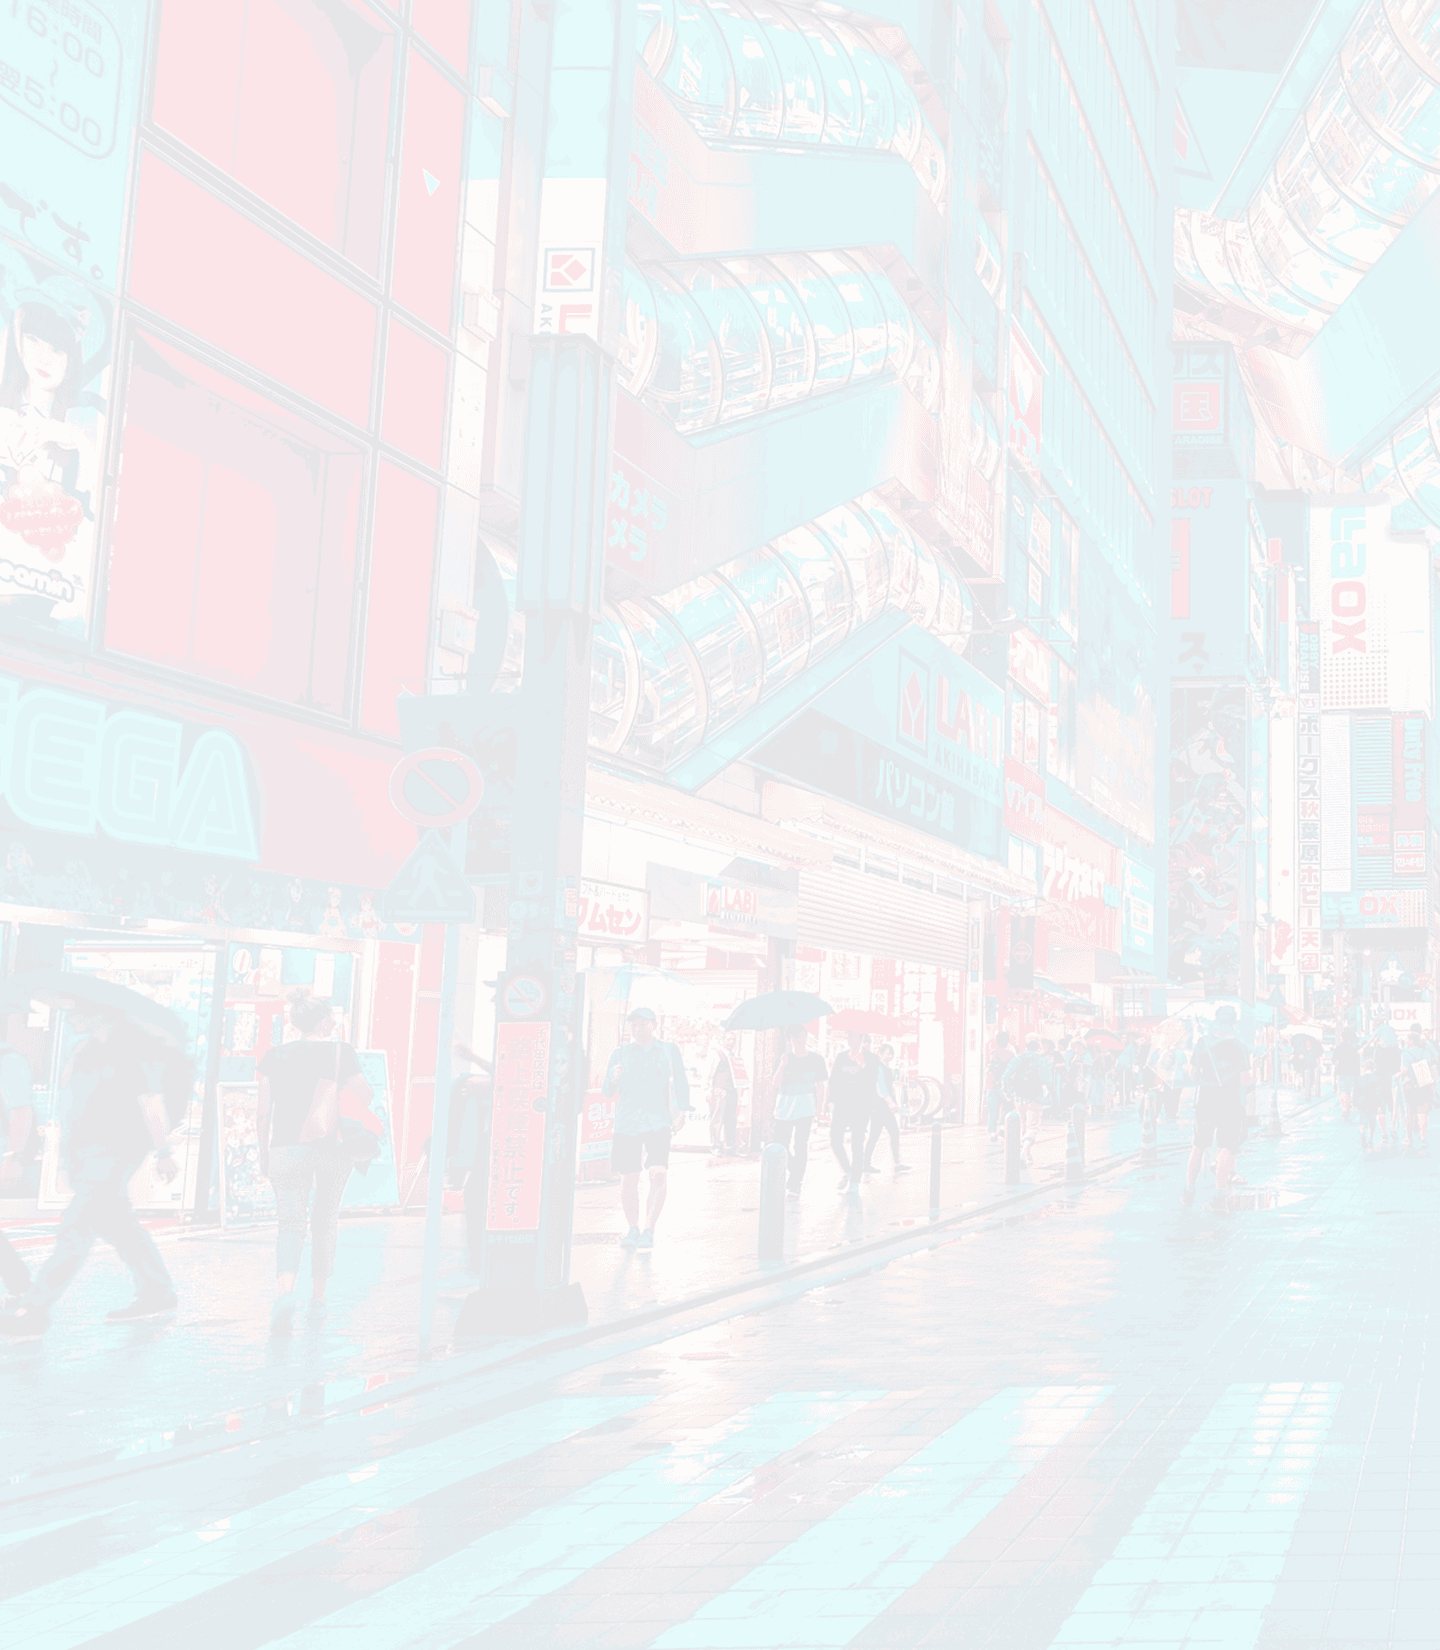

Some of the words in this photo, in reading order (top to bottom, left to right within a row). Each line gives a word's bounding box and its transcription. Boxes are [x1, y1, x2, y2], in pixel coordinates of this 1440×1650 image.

[1171, 435, 1224, 445] ARADISE
[935, 673, 1001, 769] LABI
[0, 677, 260, 860] EGA
[588, 1102, 616, 1121] au
